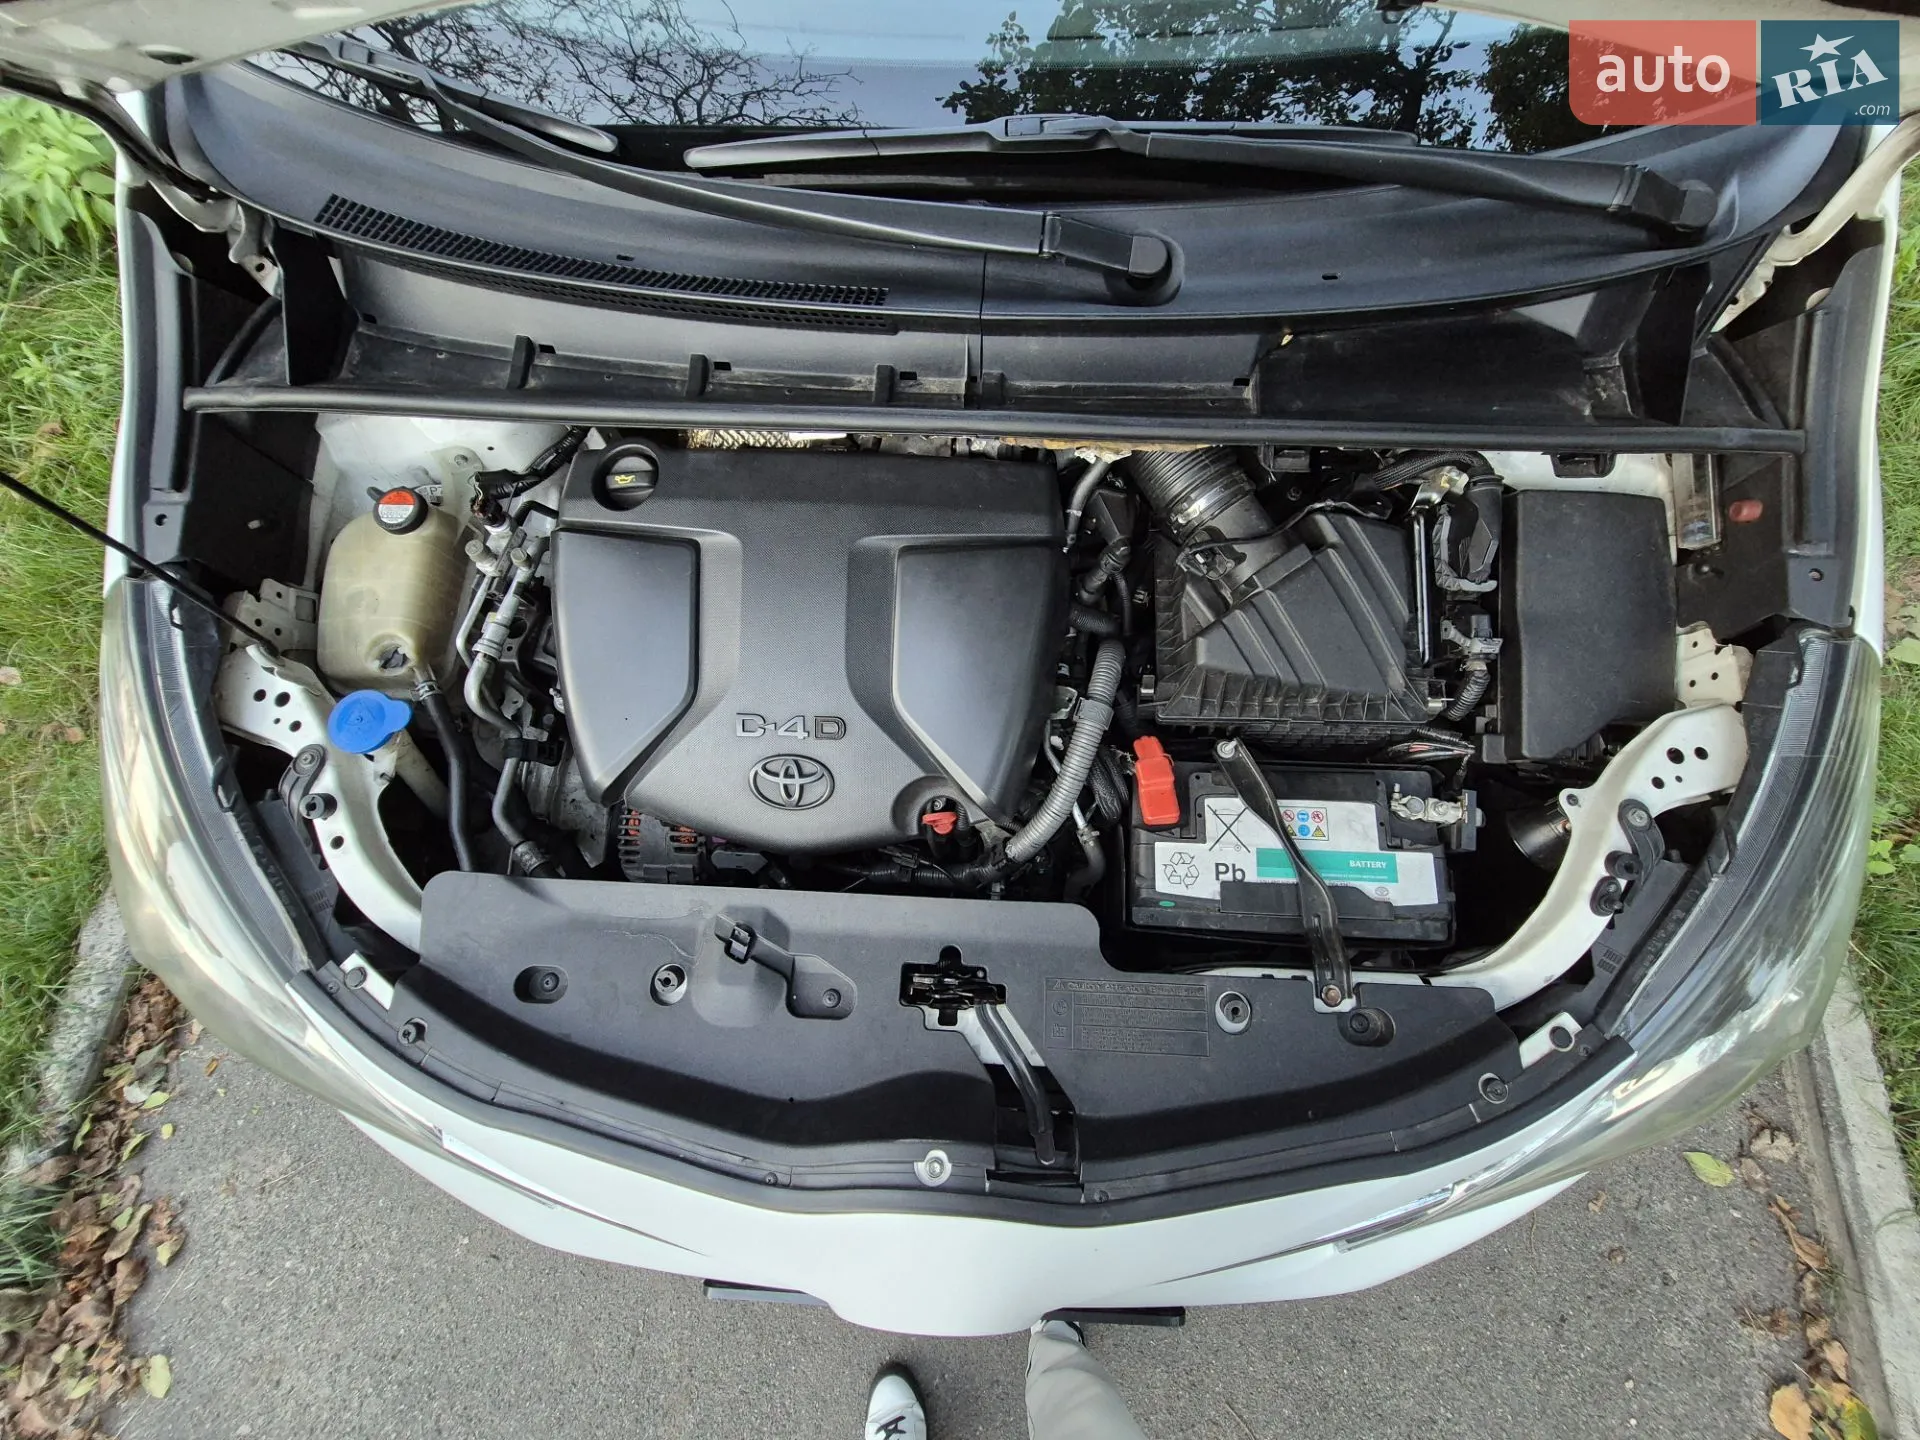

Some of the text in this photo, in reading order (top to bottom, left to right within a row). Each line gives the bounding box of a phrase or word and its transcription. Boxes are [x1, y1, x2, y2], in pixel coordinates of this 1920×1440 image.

[736, 712, 847, 740] D-4D
[1215, 862, 1246, 882] Pb
[1349, 860, 1387, 869] BATTERY
